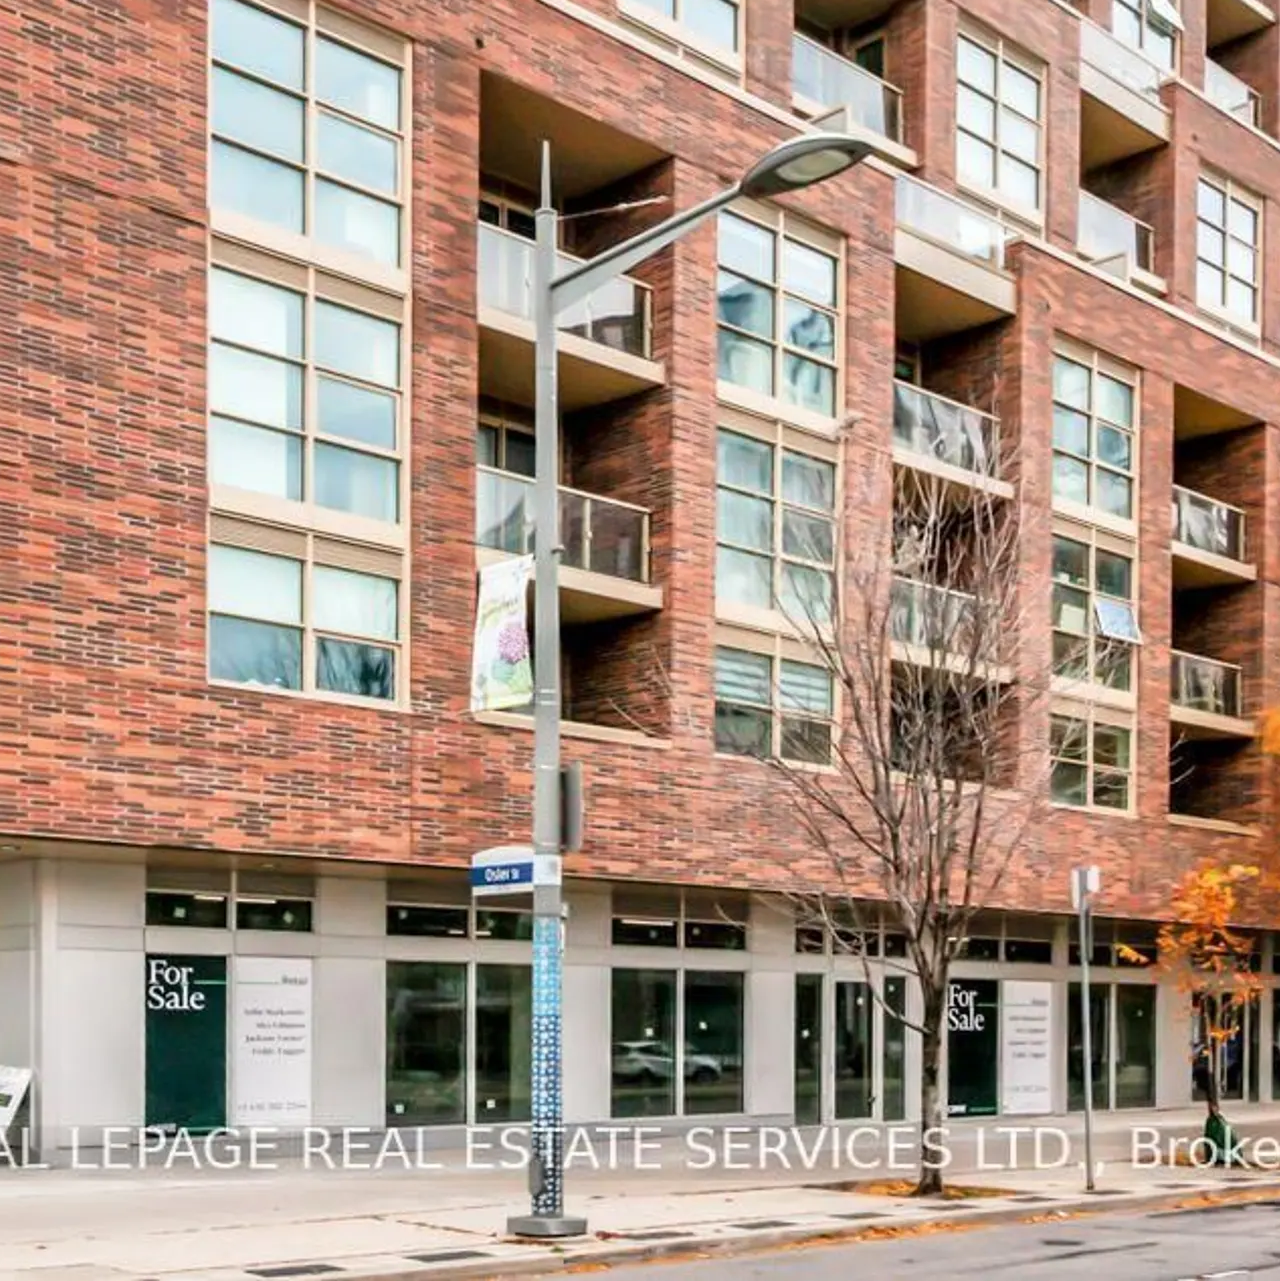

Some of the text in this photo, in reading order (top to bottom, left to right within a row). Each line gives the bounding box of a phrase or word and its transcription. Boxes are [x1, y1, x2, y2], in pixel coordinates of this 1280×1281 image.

[148, 959, 194, 985] For
[147, 984, 205, 1010] Sale
[948, 984, 978, 1007] For
[948, 1007, 985, 1031] Sale
